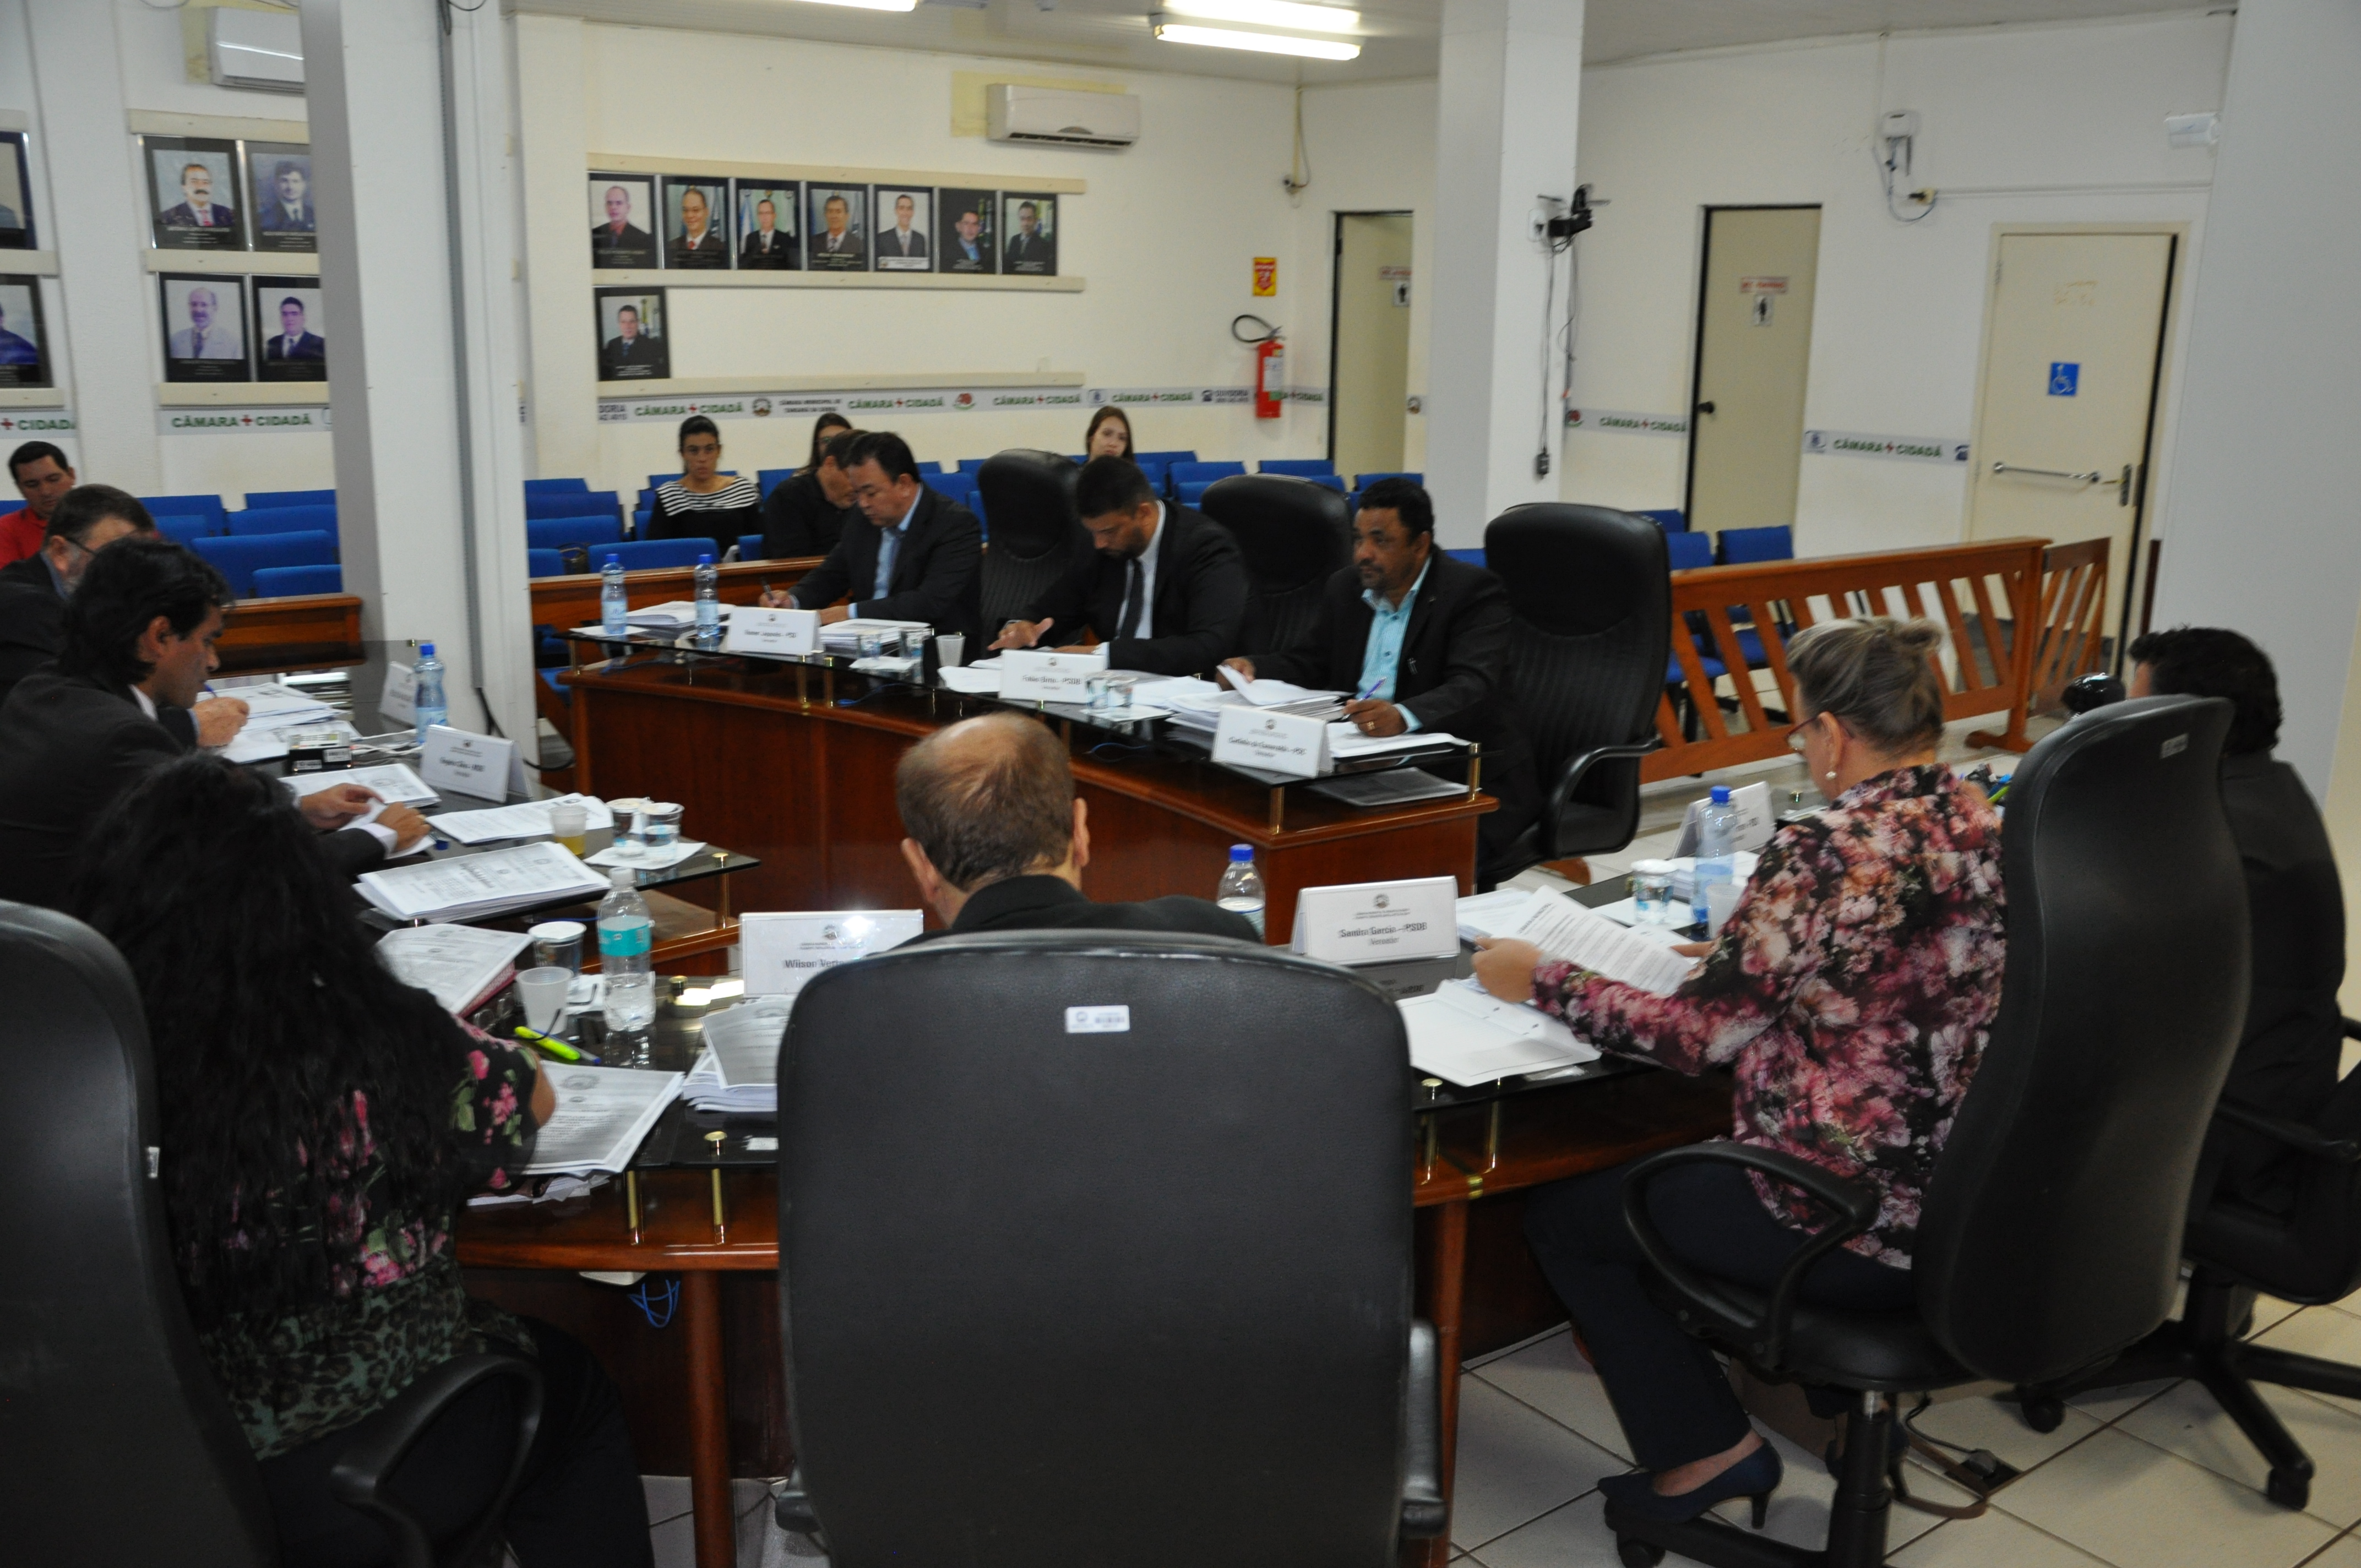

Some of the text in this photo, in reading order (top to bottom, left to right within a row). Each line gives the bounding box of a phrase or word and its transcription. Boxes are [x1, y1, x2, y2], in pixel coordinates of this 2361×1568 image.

[1339, 928, 1369, 938] Sandra
[1370, 925, 1396, 935] Garcia
[1405, 922, 1428, 932] PSDB
[785, 959, 817, 968] Wilson
